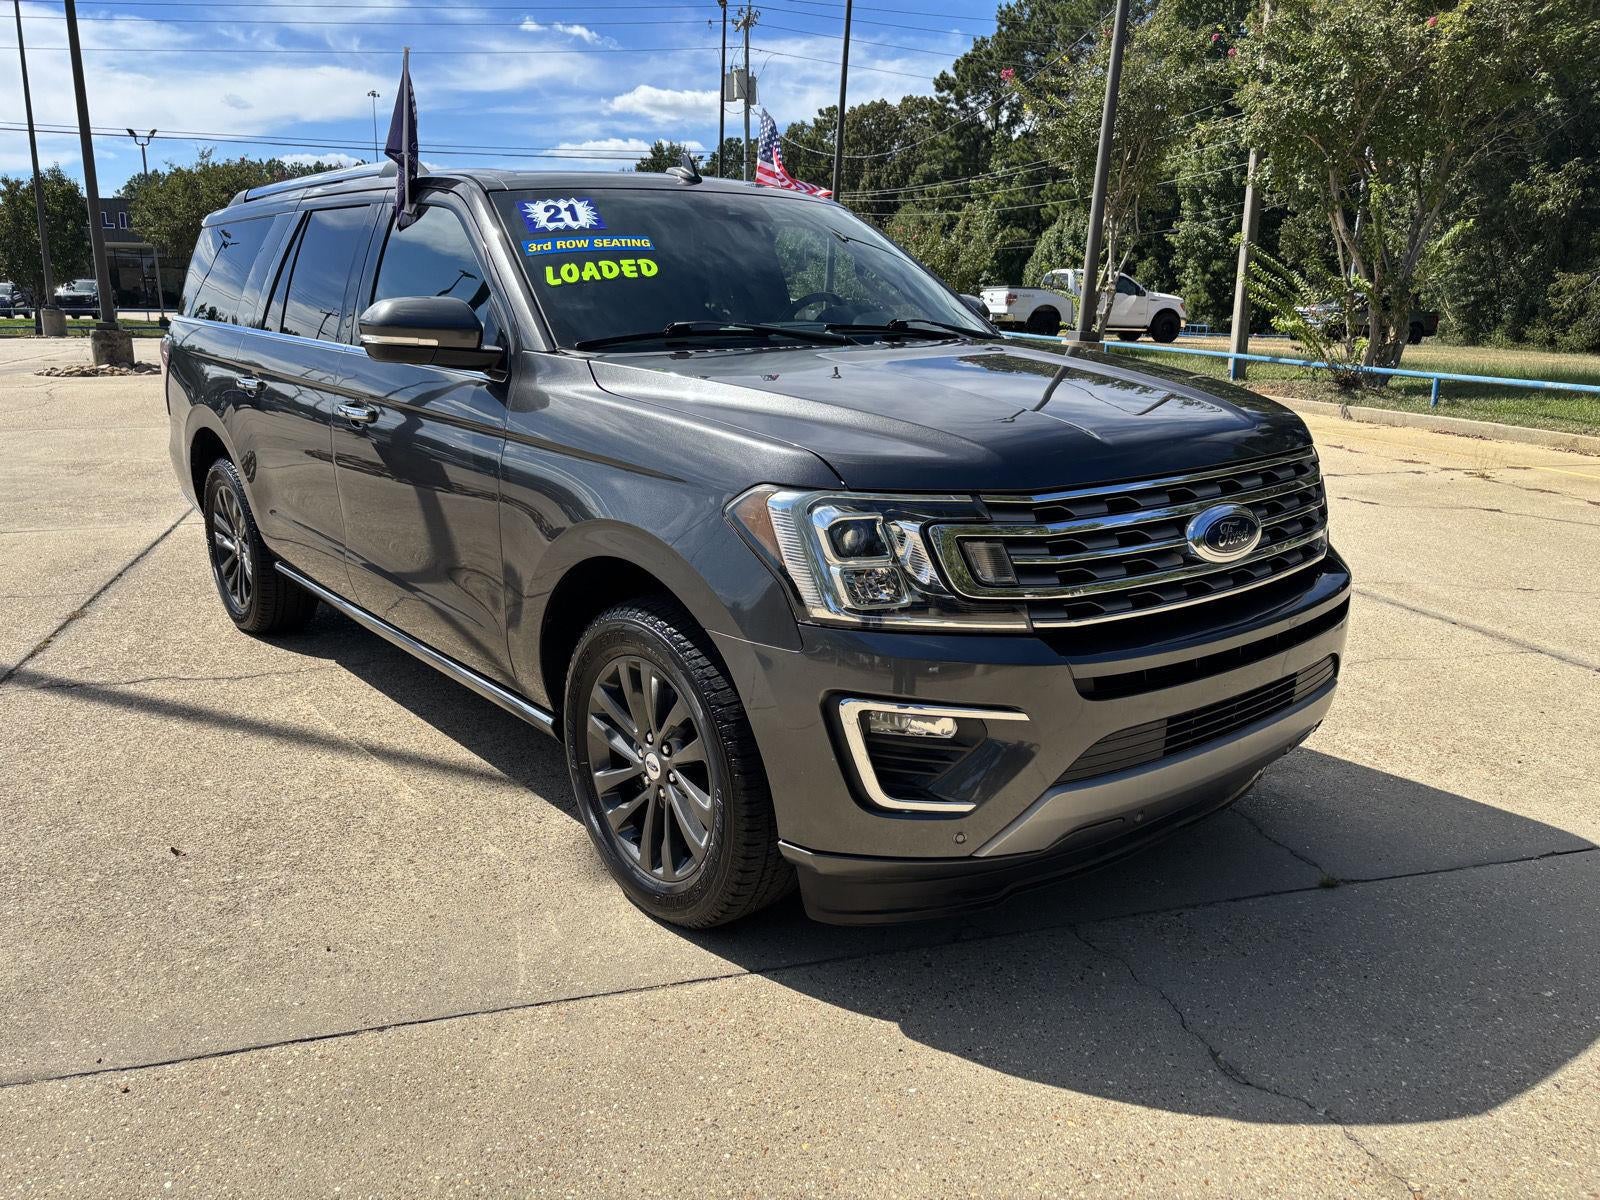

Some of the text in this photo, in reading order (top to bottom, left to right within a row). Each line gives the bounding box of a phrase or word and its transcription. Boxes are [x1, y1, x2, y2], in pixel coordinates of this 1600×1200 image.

[543, 204, 581, 224] 21
[528, 238, 651, 252] 3rd ROW SEATING
[545, 258, 659, 286] LOADED
[1218, 520, 1249, 547] Ford
